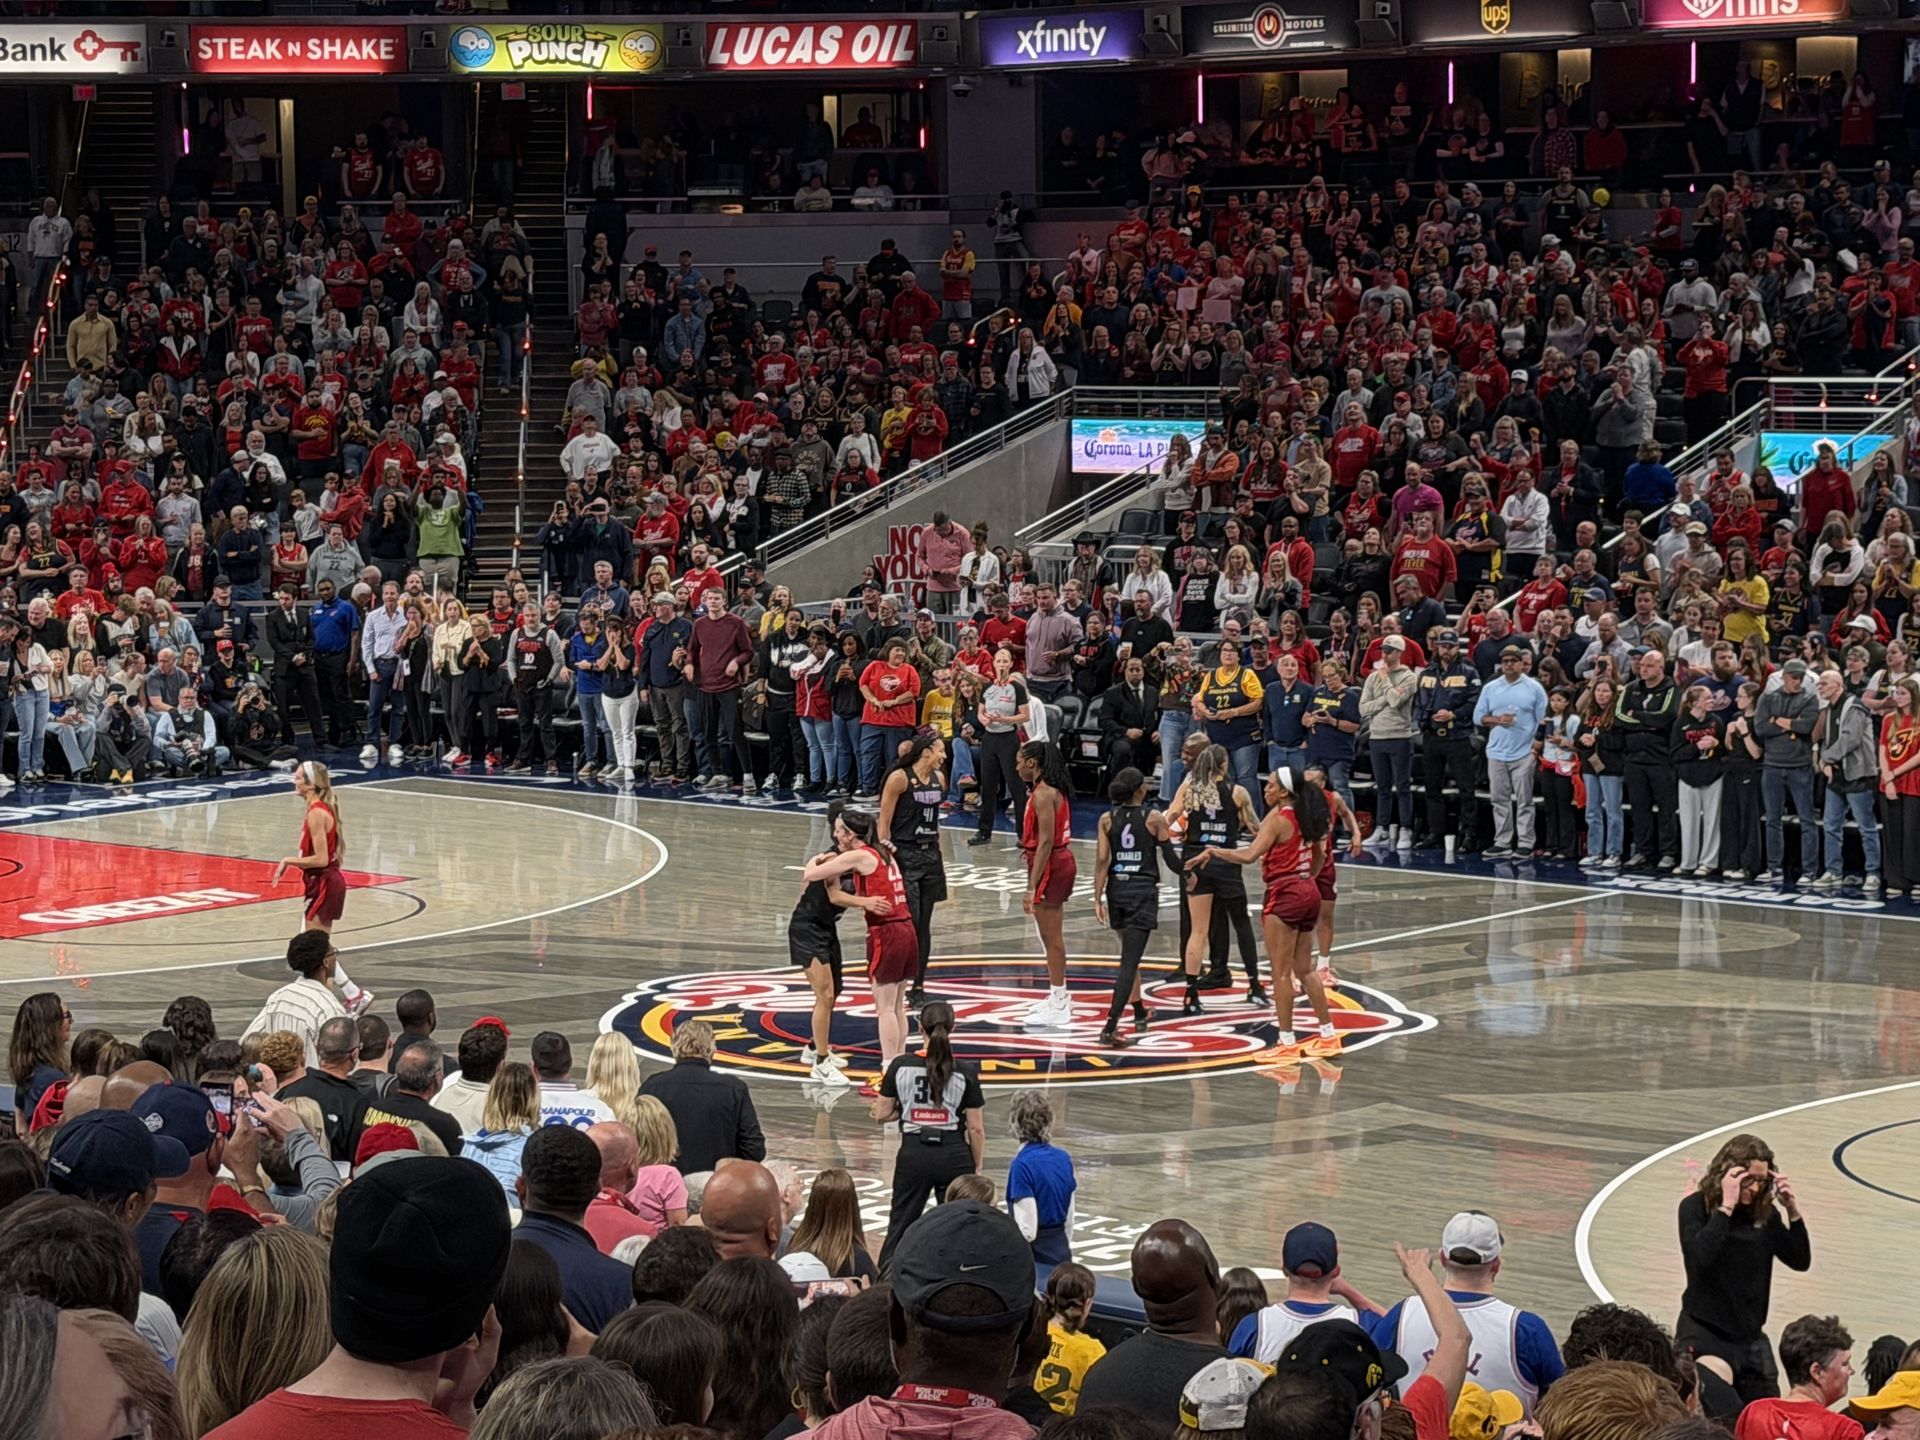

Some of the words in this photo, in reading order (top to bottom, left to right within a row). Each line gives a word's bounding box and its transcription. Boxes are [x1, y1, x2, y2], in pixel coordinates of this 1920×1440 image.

[1483, 5, 1508, 28] ups
[1284, 18, 1325, 29] MOTORS
[527, 24, 583, 43] SOUR
[1016, 19, 1107, 59] xfinity
[198, 38, 282, 60] STEAK
[287, 41, 302, 57] N
[306, 37, 396, 60] SHAKE
[708, 23, 843, 66] LUCAS
[850, 20, 916, 63] OIL
[508, 40, 609, 69] PUNCH
[1084, 439, 1132, 459] Corona
[1138, 442, 1153, 458] LA
[1402, 549, 1430, 559] INDIANA
[38, 557, 50, 567] 22
[329, 560, 341, 571] 22
[524, 652, 535, 664] 10
[1208, 686, 1239, 696] INDIANA
[1216, 695, 1231, 708] 22
[923, 807, 934, 822] 41
[1200, 822, 1227, 833] WILLIAMS
[1121, 823, 1135, 849] 6
[1116, 851, 1142, 861] CHARLES
[913, 1110, 946, 1119] Emirates
